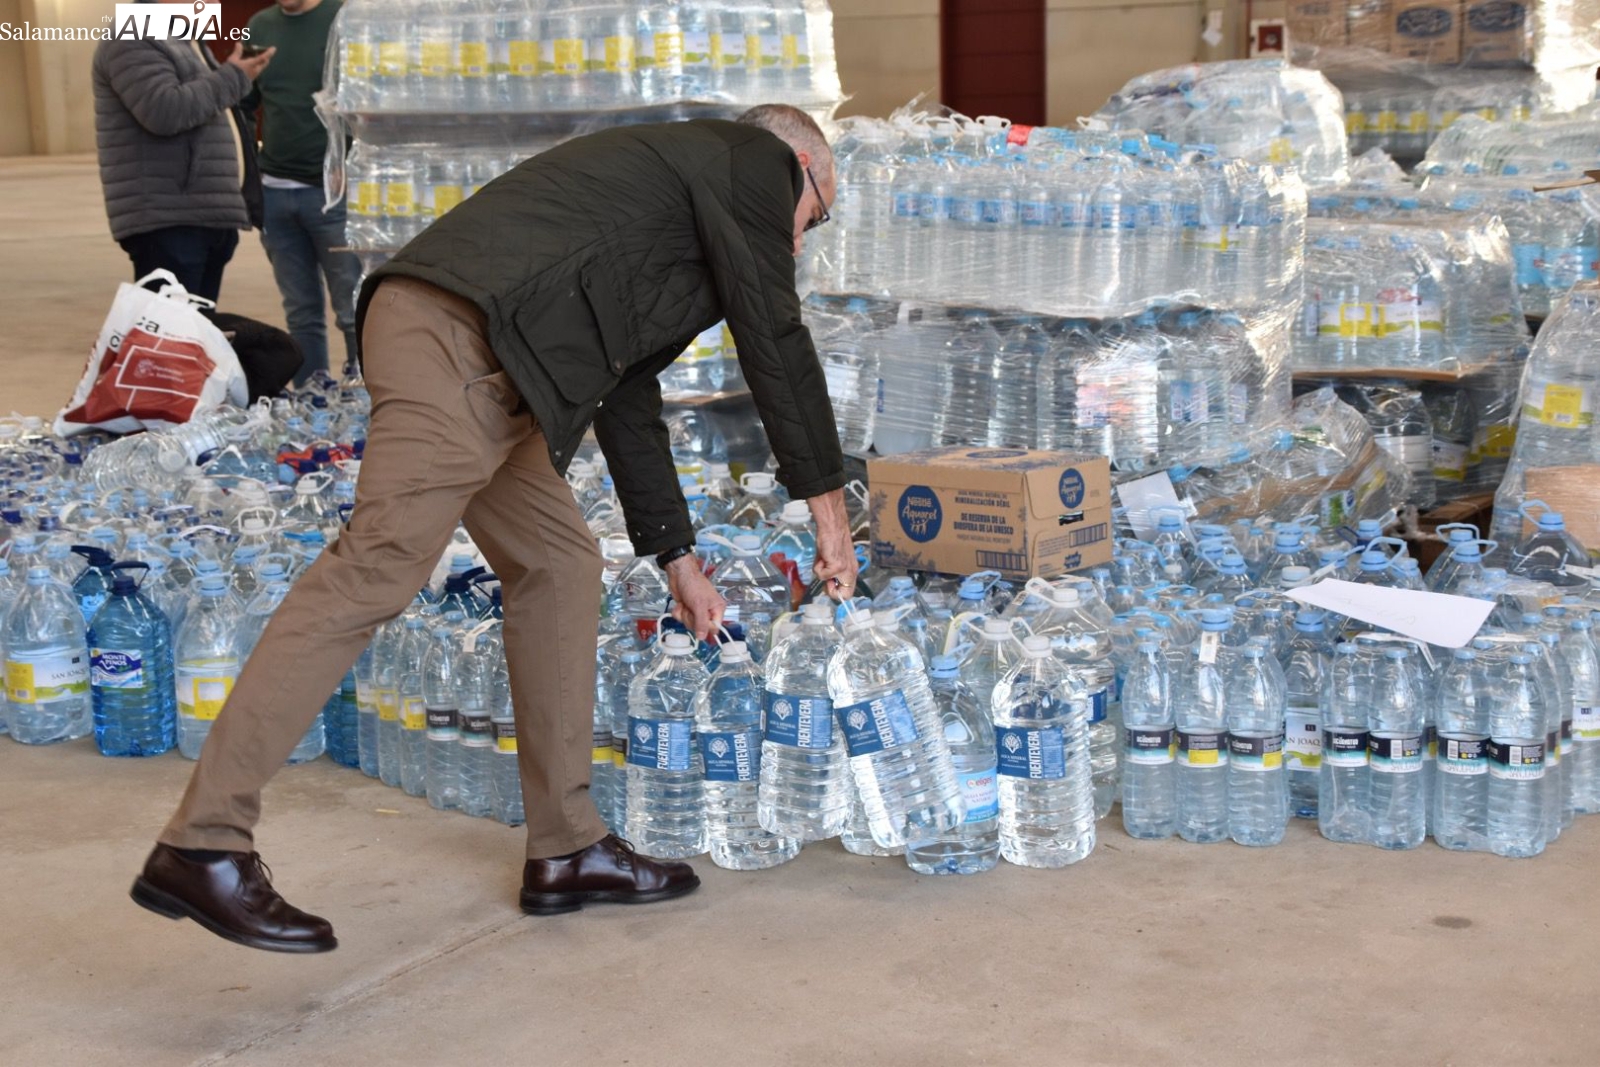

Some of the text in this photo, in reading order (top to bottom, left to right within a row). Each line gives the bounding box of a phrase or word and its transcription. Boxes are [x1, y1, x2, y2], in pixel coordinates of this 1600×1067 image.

[902, 506, 937, 523] Aquarel
[994, 525, 1014, 535] UNESCO
[657, 722, 670, 770] FUENTEVERA
[798, 699, 812, 748] FUENTEVERA
[869, 699, 897, 749] FUENTEVERA
[1297, 738, 1321, 746] JOAQ
[733, 733, 750, 781] FUENTEVERA
[1027, 730, 1042, 778] FUENTEVERA
